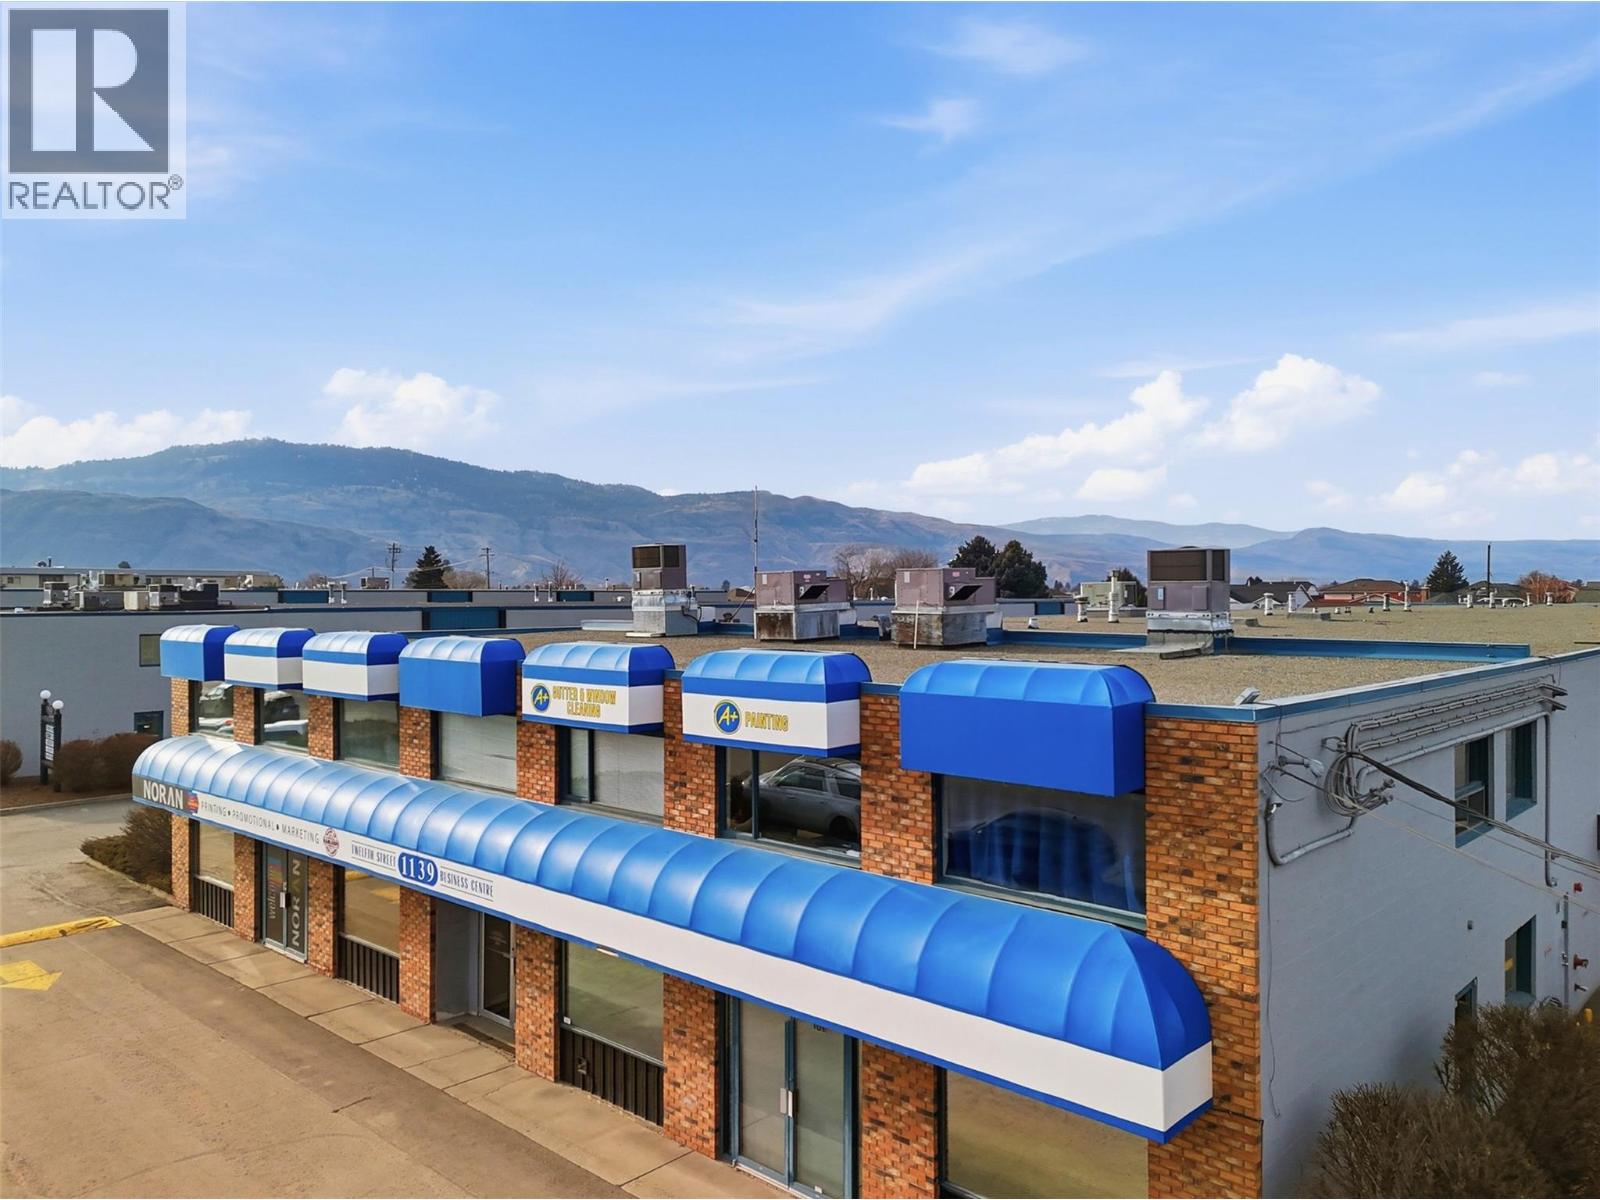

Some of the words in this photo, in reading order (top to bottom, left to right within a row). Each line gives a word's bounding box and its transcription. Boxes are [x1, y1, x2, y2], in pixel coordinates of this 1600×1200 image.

[534, 688, 549, 705] A+
[567, 701, 601, 718] CLEANING
[718, 705, 739, 726] A+
[744, 710, 789, 733] PAINTING
[143, 779, 184, 810] NORAN
[201, 800, 226, 817] PRINTING
[232, 809, 275, 832] PROMOTIONAL
[281, 823, 320, 845] MARKETING
[376, 851, 396, 868] STREET
[401, 855, 435, 883] 1139
[440, 870, 469, 889] BUSINESS
[470, 879, 494, 898] CENTRE
